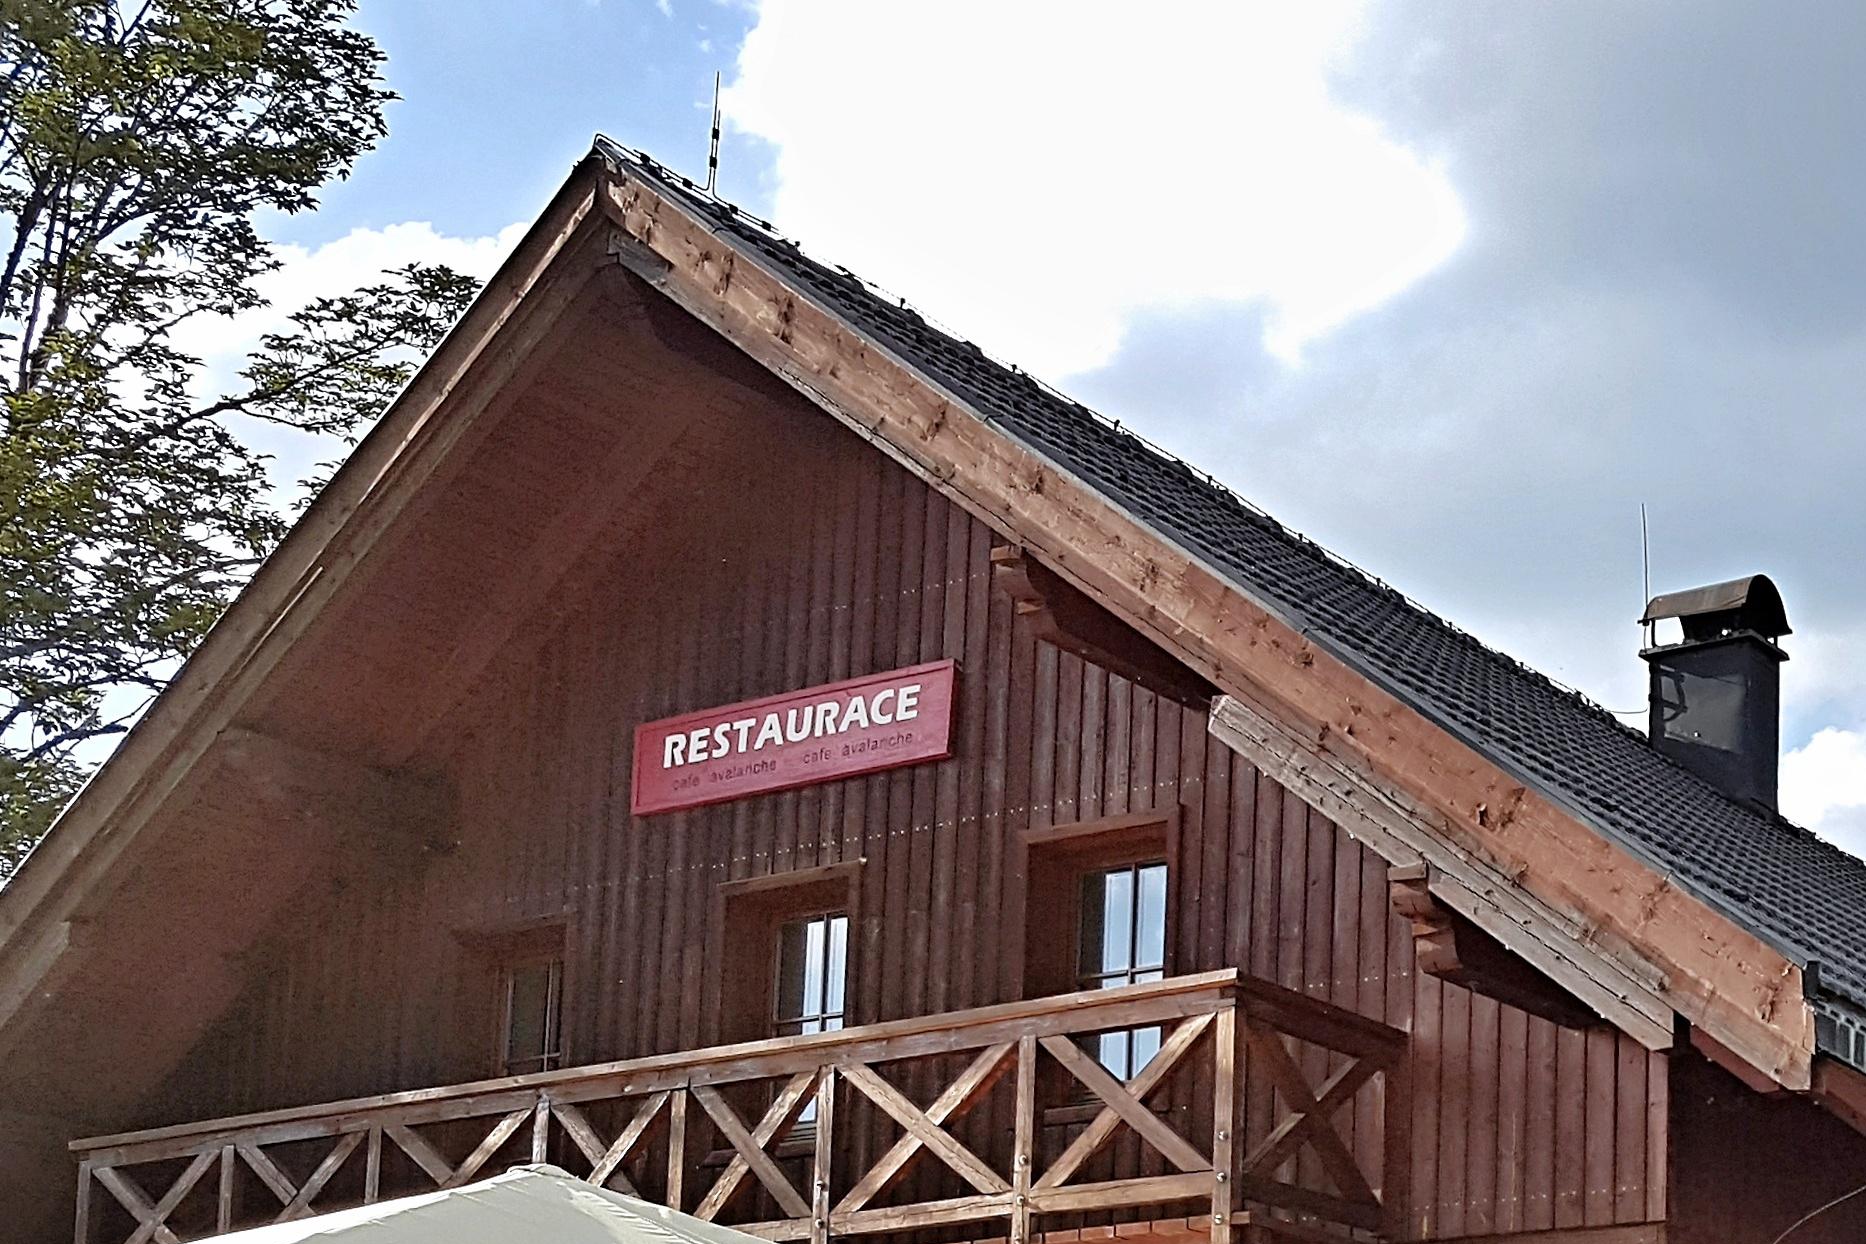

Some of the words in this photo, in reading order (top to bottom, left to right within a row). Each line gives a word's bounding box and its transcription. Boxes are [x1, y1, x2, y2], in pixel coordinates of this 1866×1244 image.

[663, 685, 921, 768] RESTAURACE
[710, 760, 777, 783] avalanche
[842, 731, 913, 756] avalanche
